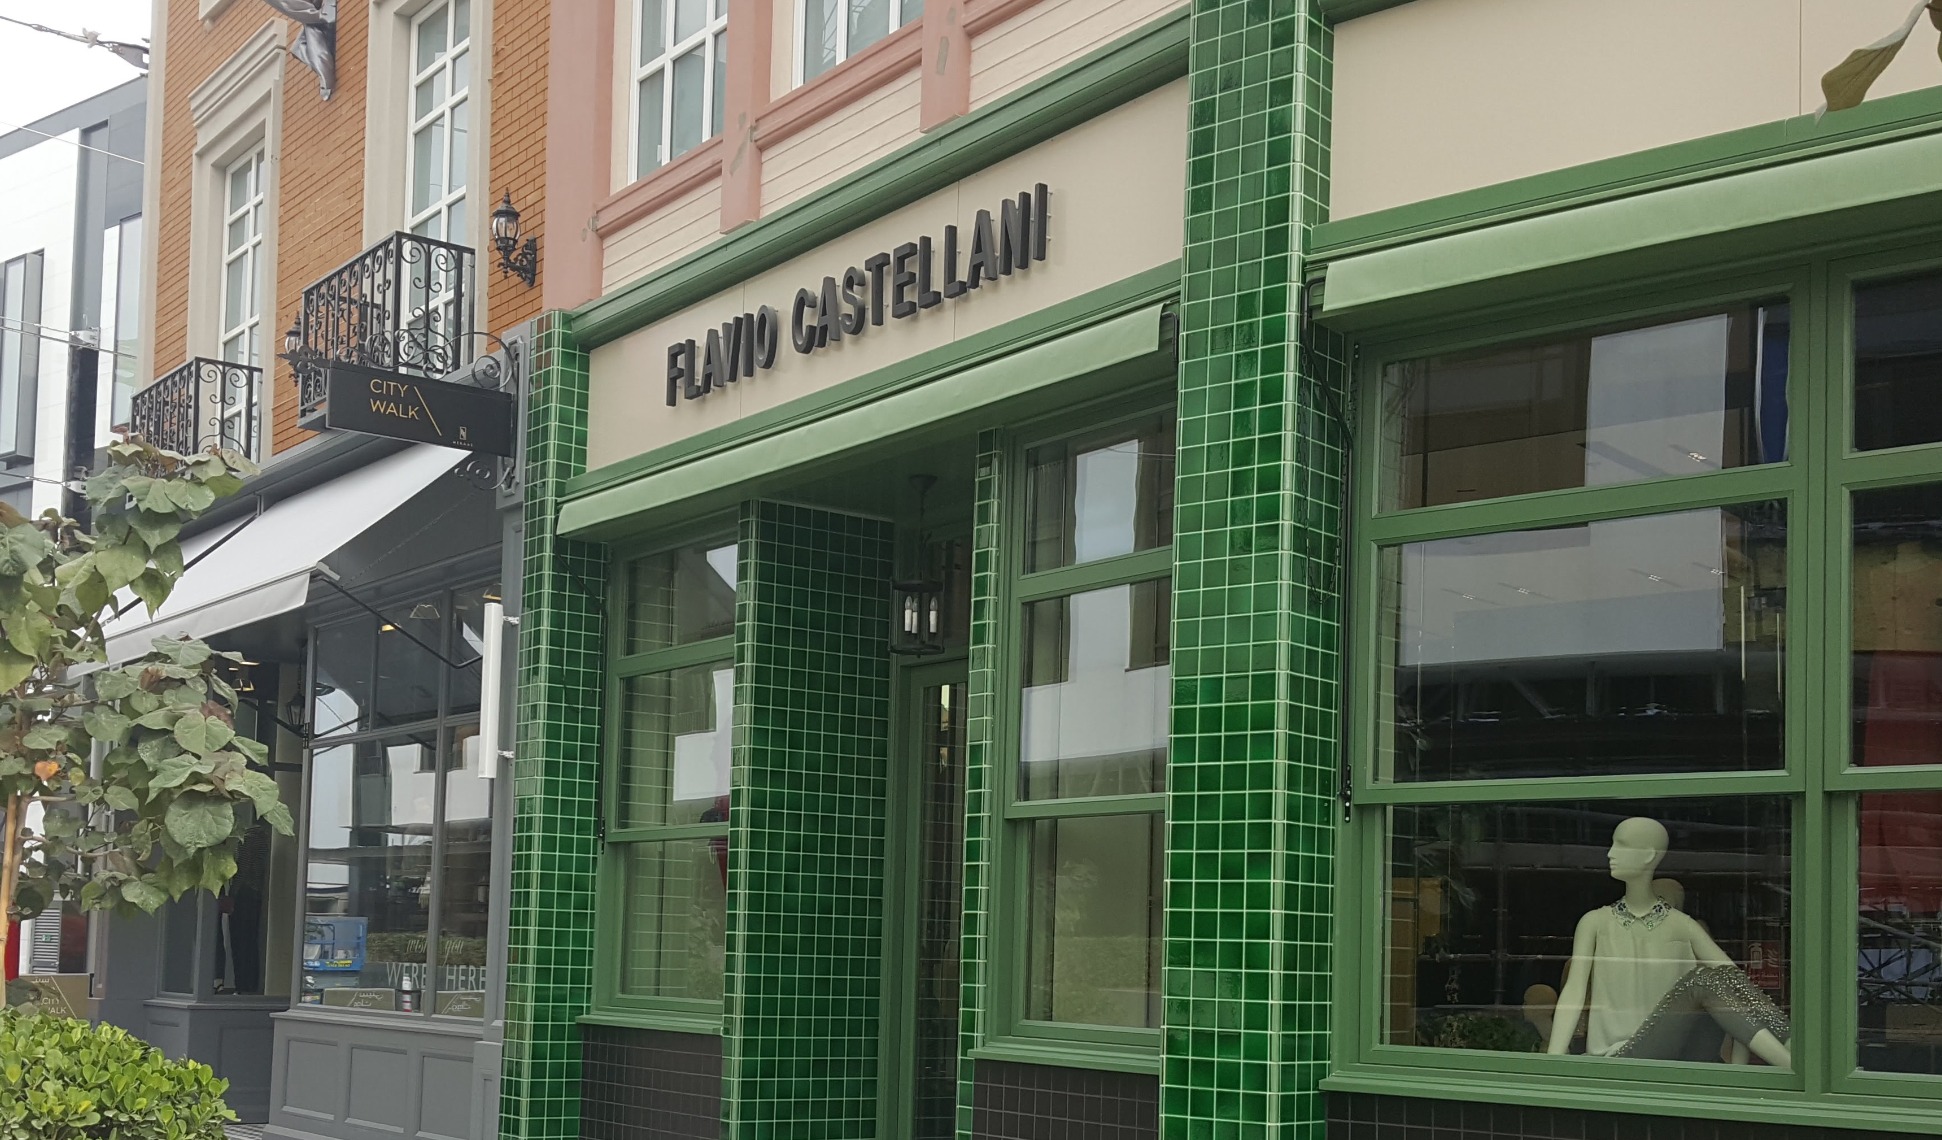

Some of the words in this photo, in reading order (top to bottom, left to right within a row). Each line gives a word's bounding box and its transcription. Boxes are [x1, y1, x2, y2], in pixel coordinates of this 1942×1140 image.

[666, 304, 778, 407] FLAVIO
[792, 182, 1048, 354] CASTELLANI
[370, 379, 408, 398] CITY
[370, 398, 419, 420] WALK
[445, 964, 487, 991] HERE
[48, 1006, 67, 1014] ALK
